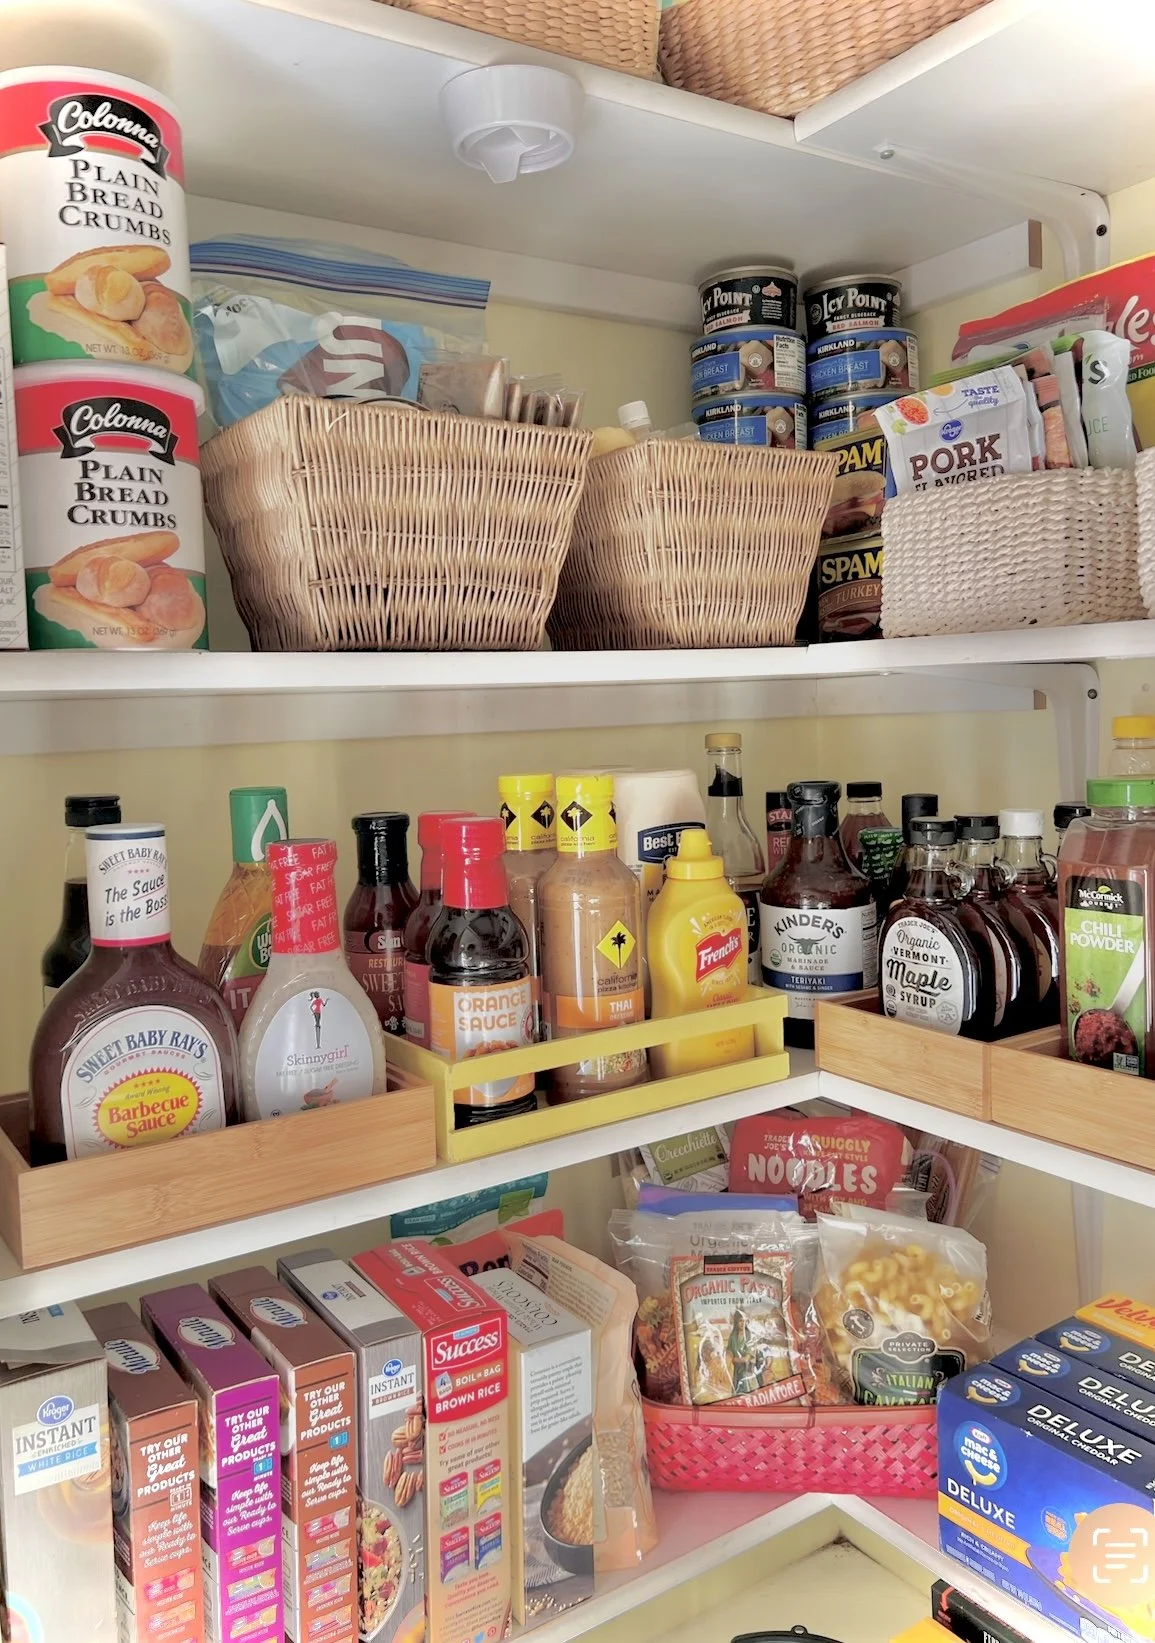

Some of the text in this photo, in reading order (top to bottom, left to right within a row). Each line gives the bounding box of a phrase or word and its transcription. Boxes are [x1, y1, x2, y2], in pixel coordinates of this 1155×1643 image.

[57, 101, 160, 148] Colonna
[69, 158, 160, 197] PLAIN
[65, 181, 164, 221] BREAD
[58, 205, 172, 246] CRUMBS
[713, 287, 752, 309] POINT
[822, 288, 887, 320] ICY POINT
[849, 320, 879, 329] SALMON
[817, 339, 855, 354] KIRKLAND
[704, 364, 728, 378] BREAST
[839, 361, 869, 375] BREAST
[962, 386, 999, 397] TASTE
[70, 402, 168, 439] Colonna
[706, 404, 741, 417] KIRKLAND
[818, 405, 855, 419] KIRKLAND
[909, 433, 1001, 481] PORK
[80, 459, 164, 484] PLAIN
[75, 482, 169, 506] BREAD
[67, 505, 177, 530] CRUMBS
[835, 584, 880, 605] TURKEY
[312, 845, 327, 859] FAT
[643, 833, 674, 851] Best
[128, 848, 152, 859] BABY
[105, 874, 164, 904] The Sauce
[310, 880, 326, 895] FAT
[1078, 888, 1124, 904] McCormick
[316, 895, 335, 911] FREE
[106, 912, 115, 927] is
[120, 906, 141, 923] the
[311, 916, 328, 931] FAT
[774, 914, 844, 939] KINDER'S
[317, 932, 336, 948] FREE
[896, 929, 941, 951] Organic
[1081, 920, 1122, 938] CHILI
[699, 935, 740, 970] French's
[781, 942, 837, 955] ORGANIC
[1070, 932, 1135, 954] POWDER
[893, 946, 946, 965] VERMONT
[791, 976, 826, 985] TERIYAKI
[886, 958, 953, 996] Maple
[458, 990, 526, 1011] ORANGE
[610, 999, 632, 1013] THAI
[900, 990, 936, 1009] SYRUP
[458, 1013, 516, 1032] SAUCE
[76, 1030, 208, 1084] SWEET BABY RAY'S
[286, 1045, 349, 1067] Skinnygirl
[124, 1092, 145, 1101] Award
[109, 1094, 189, 1124] Barbecue
[126, 1112, 175, 1139] Sauce
[654, 1131, 717, 1163] Orecchiette
[764, 1143, 787, 1151] JOE'S
[747, 1153, 878, 1196] NOODLES
[438, 1276, 480, 1309] Success
[684, 1279, 736, 1303] ORGANIC
[253, 1297, 304, 1328] Minute
[180, 1317, 230, 1349] Minute
[107, 1339, 153, 1374] Minute
[434, 1331, 498, 1365] Success
[385, 1361, 402, 1376] Kroger
[455, 1364, 501, 1387] BOIL BAG
[304, 1382, 346, 1401] TRY OUR
[370, 1371, 415, 1396] INSTANT
[886, 1374, 934, 1389] ITALIAN
[980, 1378, 1003, 1393] mac
[310, 1393, 340, 1408] OTHER
[435, 1382, 501, 1414] BROWN RICE
[744, 1379, 801, 1408] RADIATORE
[1079, 1388, 1121, 1412] ORIGINAL
[42, 1403, 70, 1421] Kroger
[225, 1405, 269, 1427] TRY OUR
[309, 1400, 343, 1426] Great
[15, 1415, 97, 1455] INSTANT
[232, 1419, 263, 1433] OTHER
[301, 1417, 351, 1440] PRODUCTS
[974, 1430, 990, 1442] Kraft
[1027, 1404, 1143, 1465] DELUXE
[37, 1440, 76, 1457] ENRICHED
[140, 1434, 188, 1457] TRY OUR
[231, 1426, 267, 1451] Great
[965, 1437, 998, 1462] mac &
[1027, 1416, 1119, 1466] ORIGINAL CHEDDAR
[28, 1448, 90, 1473] WHITE RICE
[148, 1446, 182, 1463] OTHER
[221, 1441, 276, 1467] PRODUCTS
[309, 1454, 345, 1474] Keep life
[147, 1454, 186, 1482] Great
[304, 1464, 349, 1486] simple with
[137, 1470, 195, 1497] PRODUCTS
[231, 1482, 269, 1501] Keep life
[301, 1473, 352, 1499] our Ready to
[226, 1491, 273, 1514] simple with
[305, 1486, 348, 1508] Serve cups.
[947, 1477, 1016, 1530] DELUXE
[172, 1512, 188, 1525] life
[223, 1502, 276, 1526] our Ready to
[227, 1516, 273, 1537] Serve cups.
